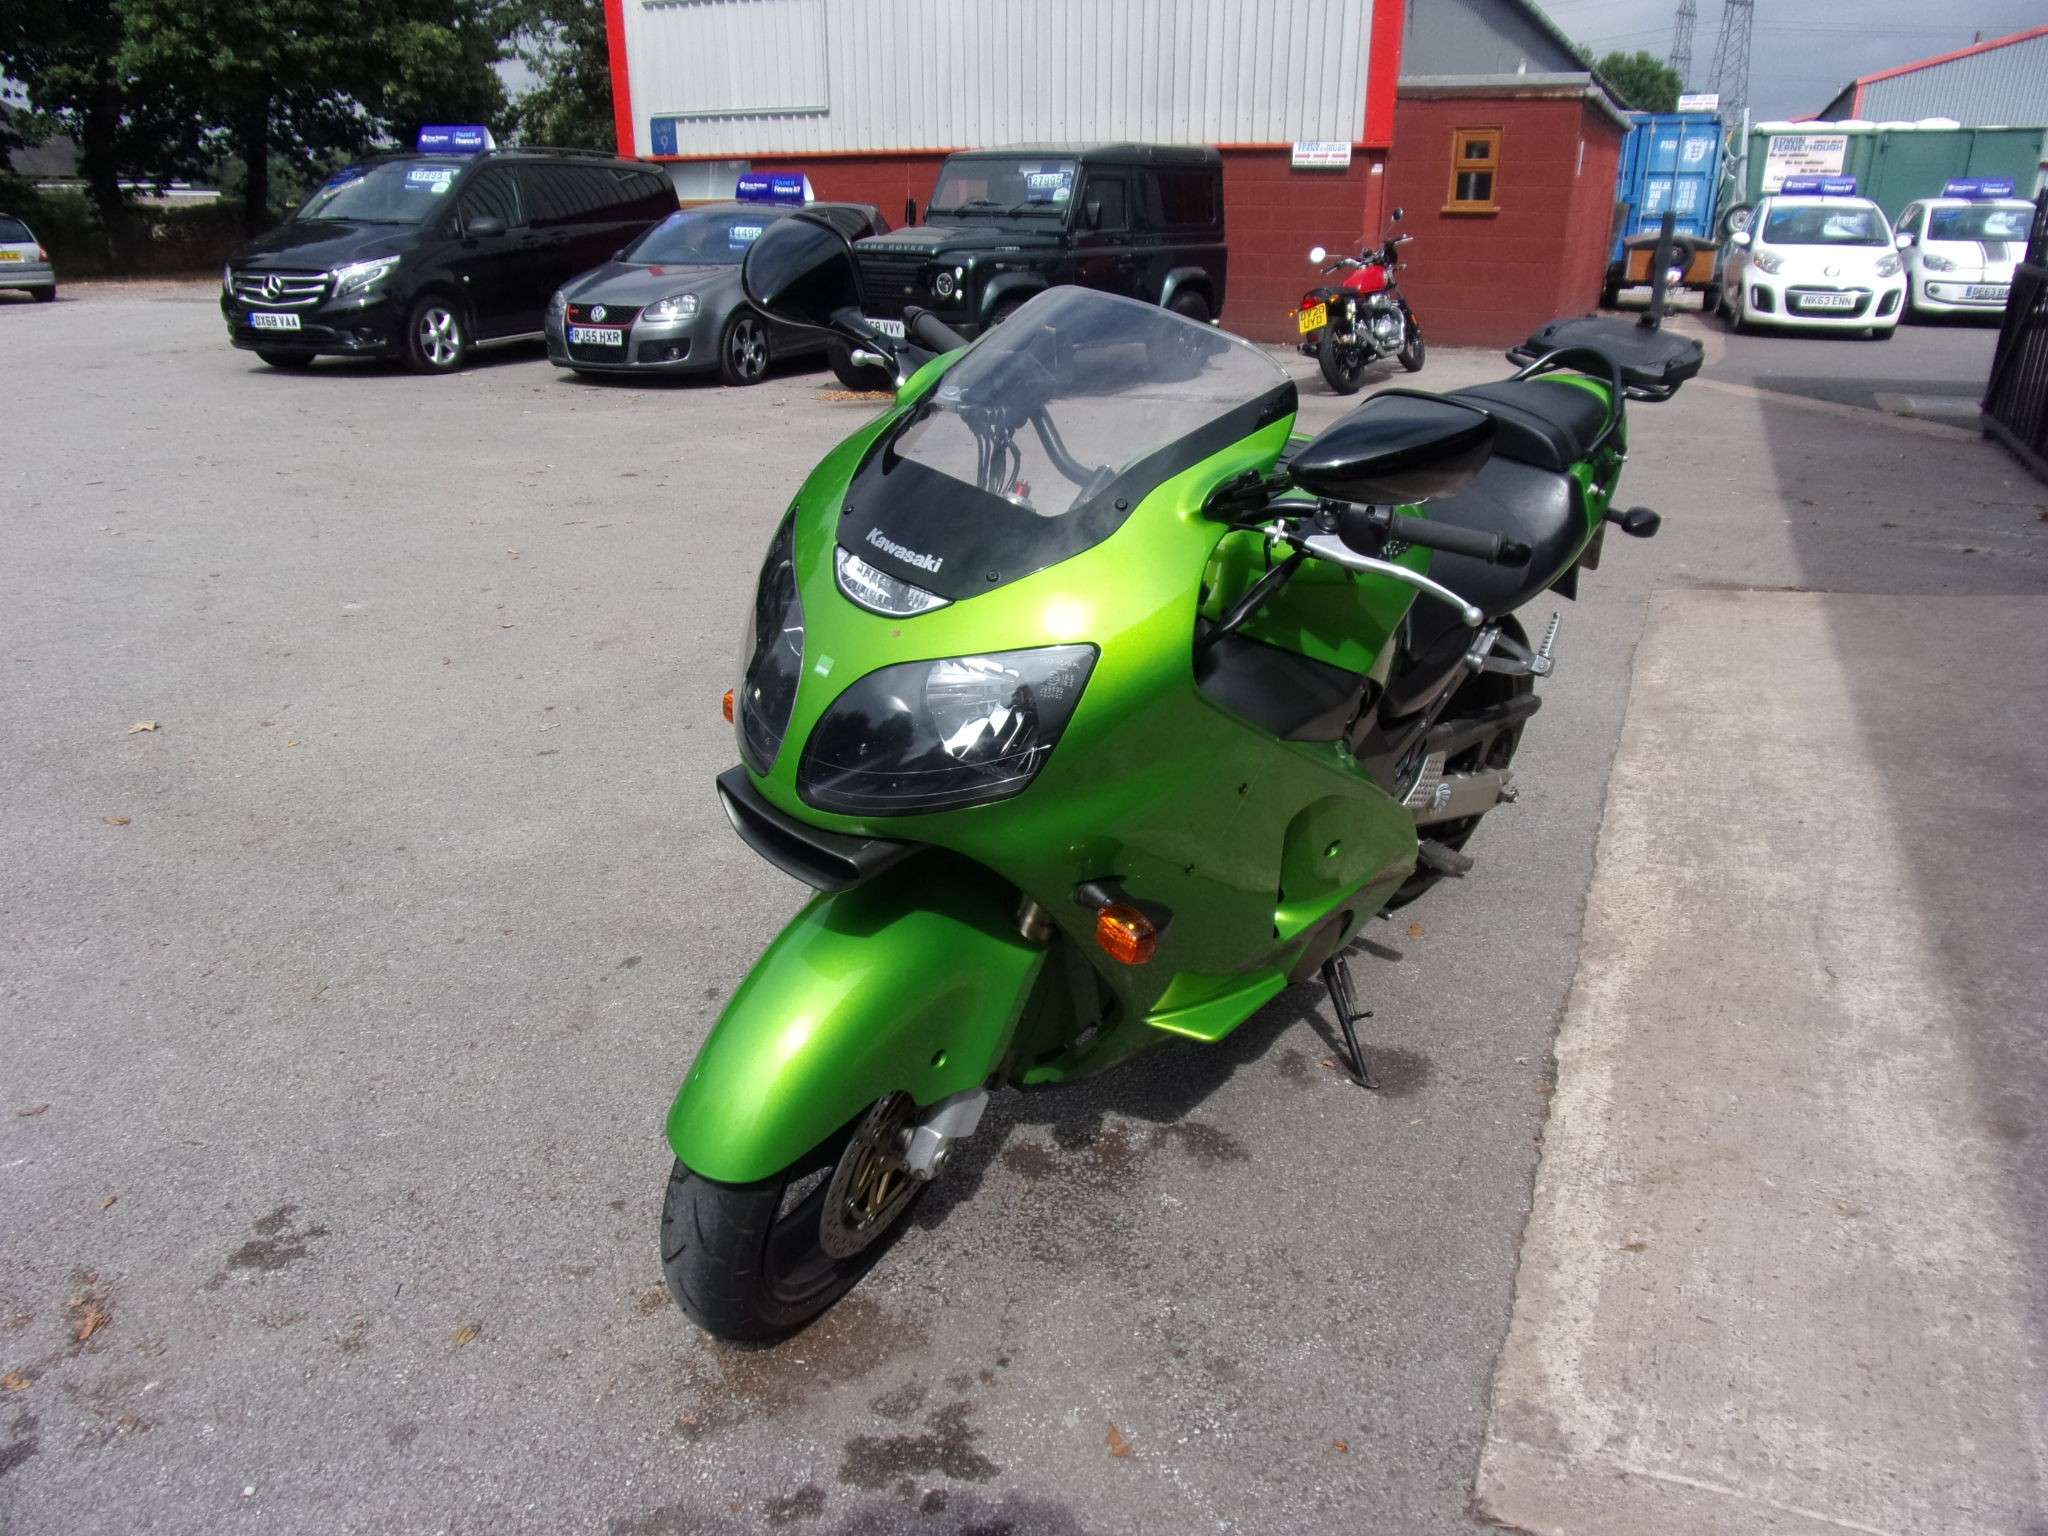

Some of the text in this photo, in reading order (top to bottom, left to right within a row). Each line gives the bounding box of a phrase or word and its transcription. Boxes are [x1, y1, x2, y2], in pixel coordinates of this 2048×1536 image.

[1774, 136, 1806, 144] EDWIN
[1773, 142, 1843, 151] FERNEYHOUGH
[600, 331, 621, 343] HXR
[866, 527, 944, 573] Kawasaki
